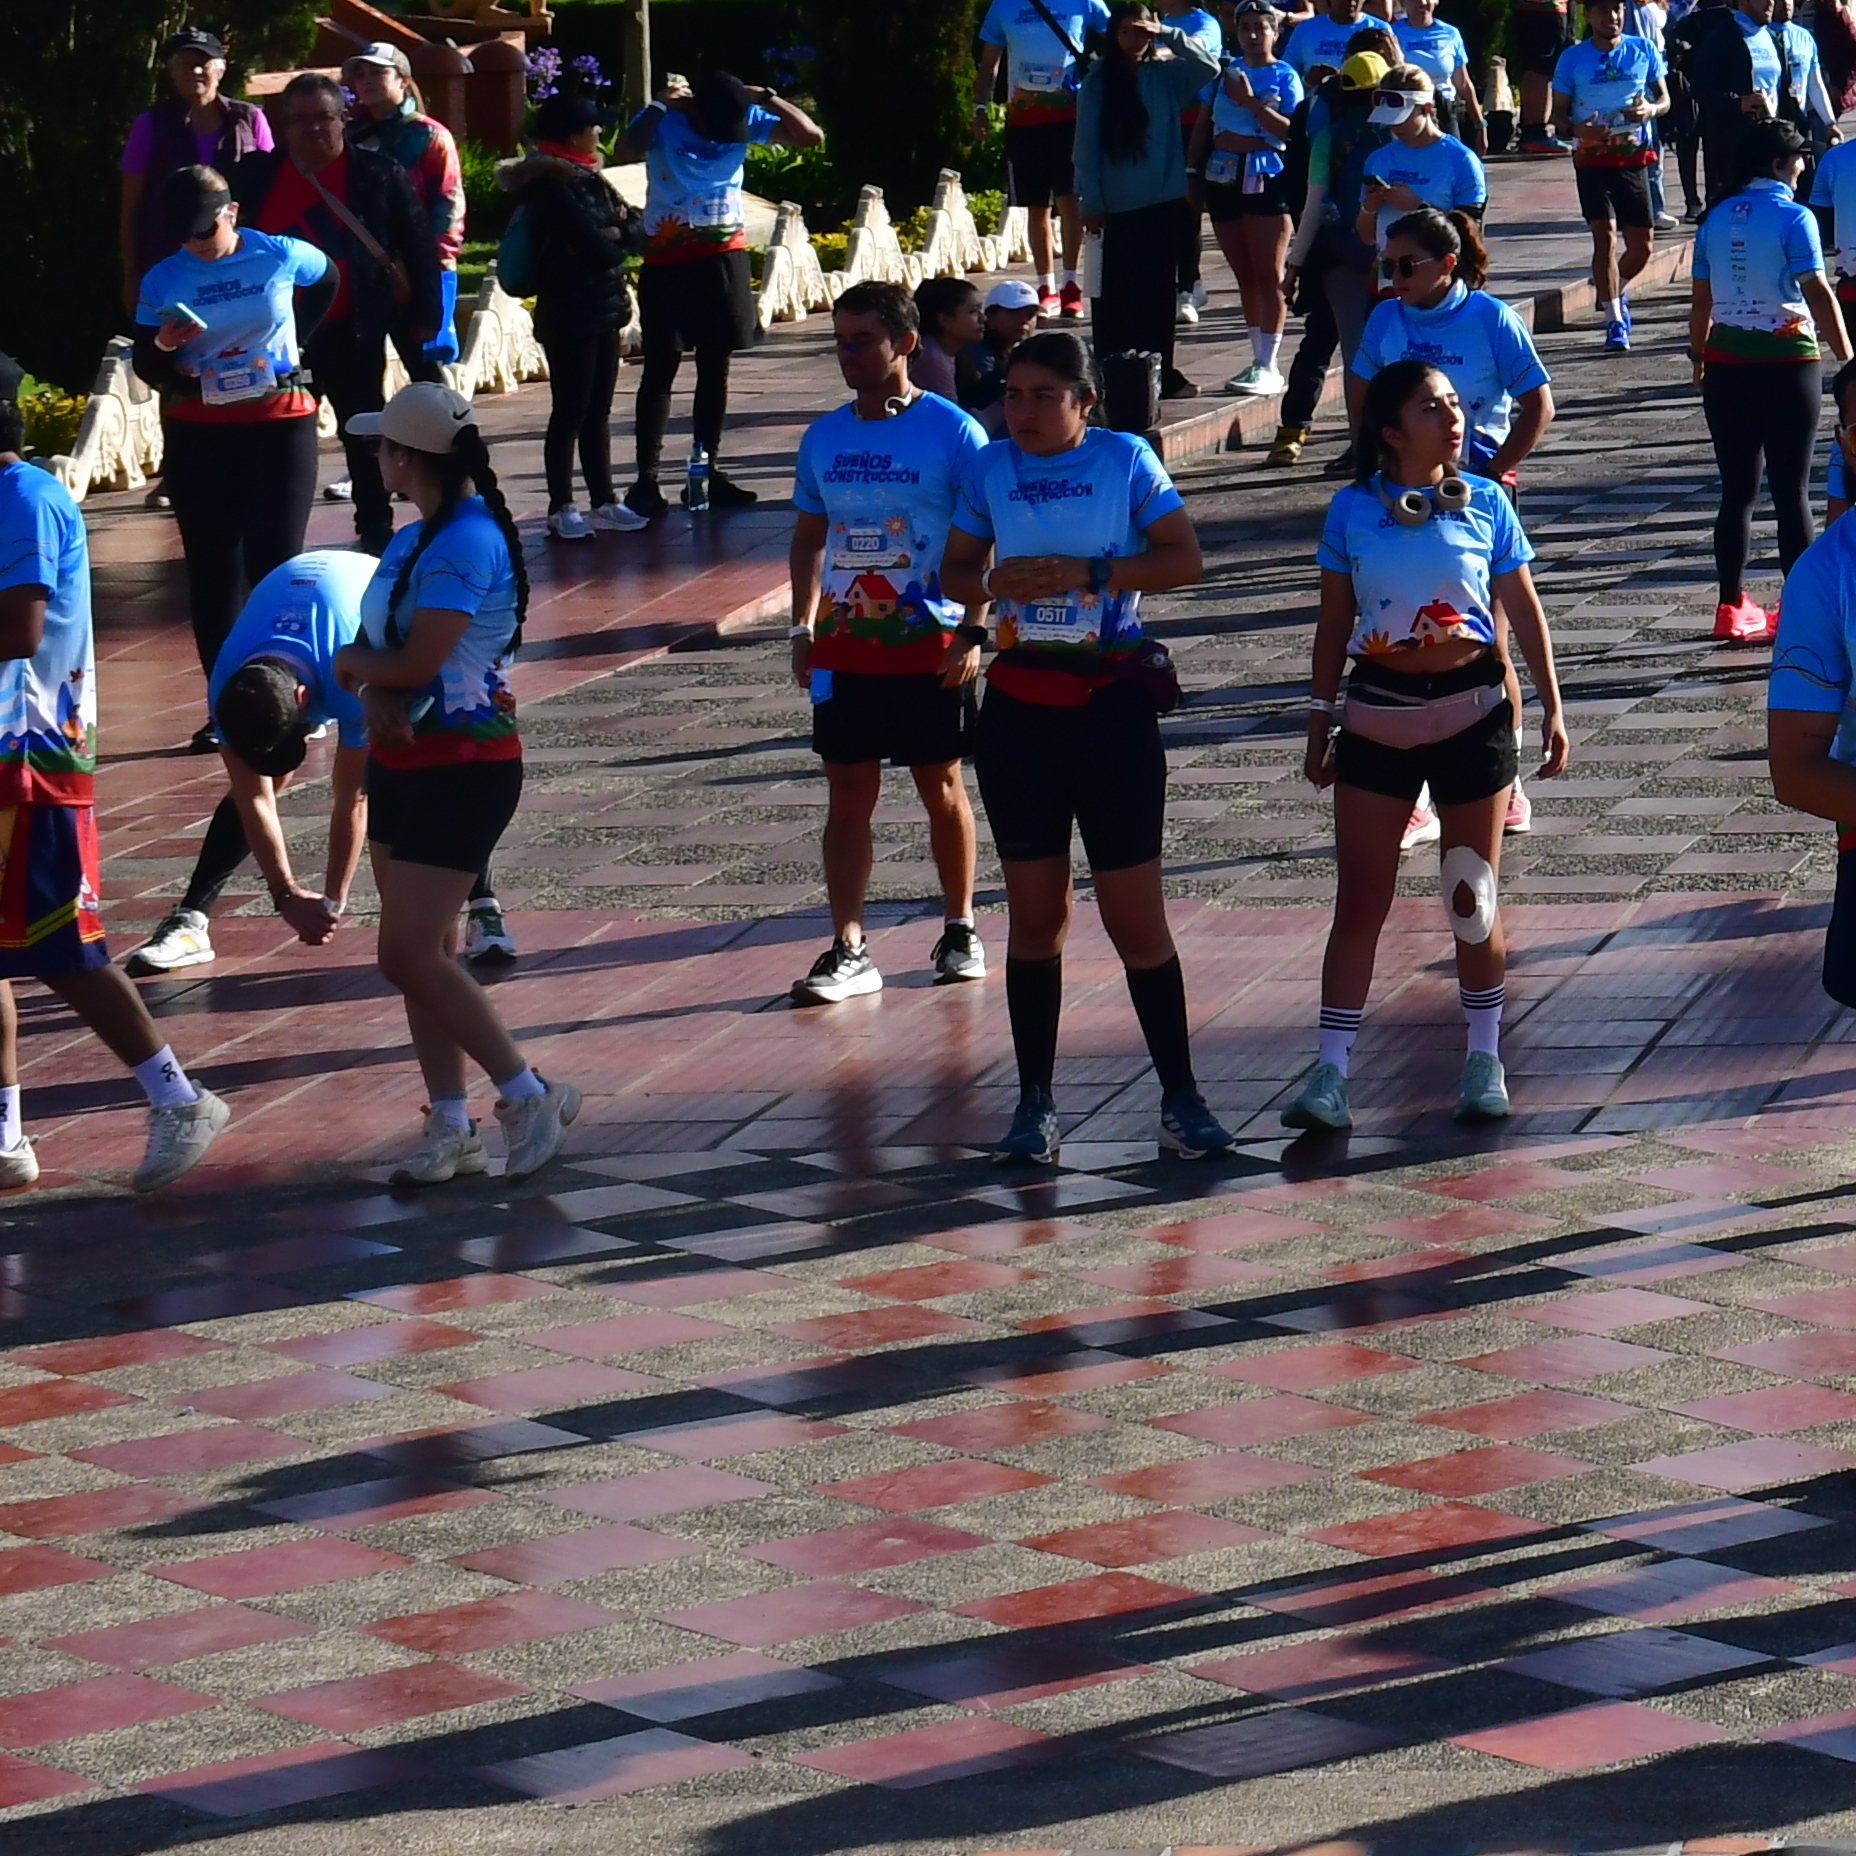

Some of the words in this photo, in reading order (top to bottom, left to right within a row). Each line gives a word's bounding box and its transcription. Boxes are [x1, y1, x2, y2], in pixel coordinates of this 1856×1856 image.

[832, 450, 893, 471] SUEÑOS
[822, 467, 921, 485] CONSTRUCCIÓN
[851, 535, 881, 550] 0220
[1035, 606, 1067, 623] 0511
